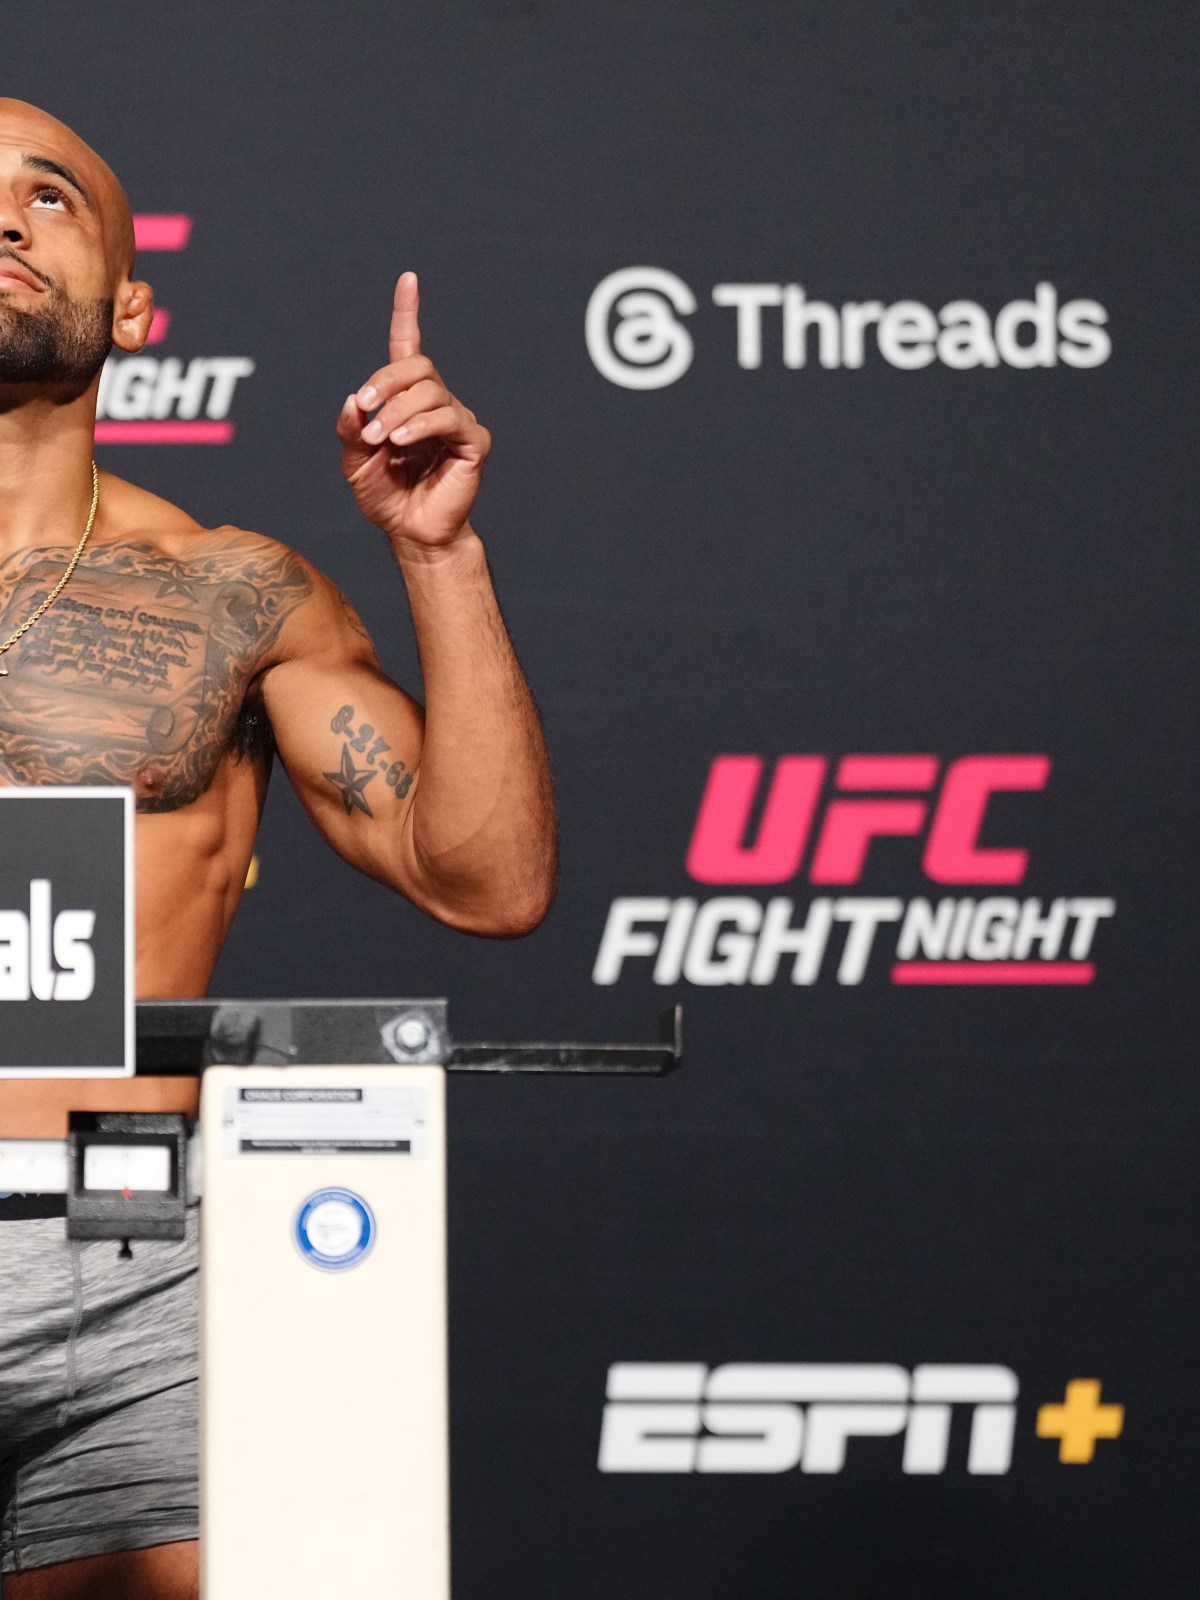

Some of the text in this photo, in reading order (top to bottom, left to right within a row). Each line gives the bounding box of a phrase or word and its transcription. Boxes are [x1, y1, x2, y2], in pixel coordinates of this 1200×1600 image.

[712, 281, 1111, 370] Threads
[96, 356, 255, 420] IGHT
[686, 755, 1051, 885] UFC
[593, 897, 1115, 986] FIGHT NIGHT
